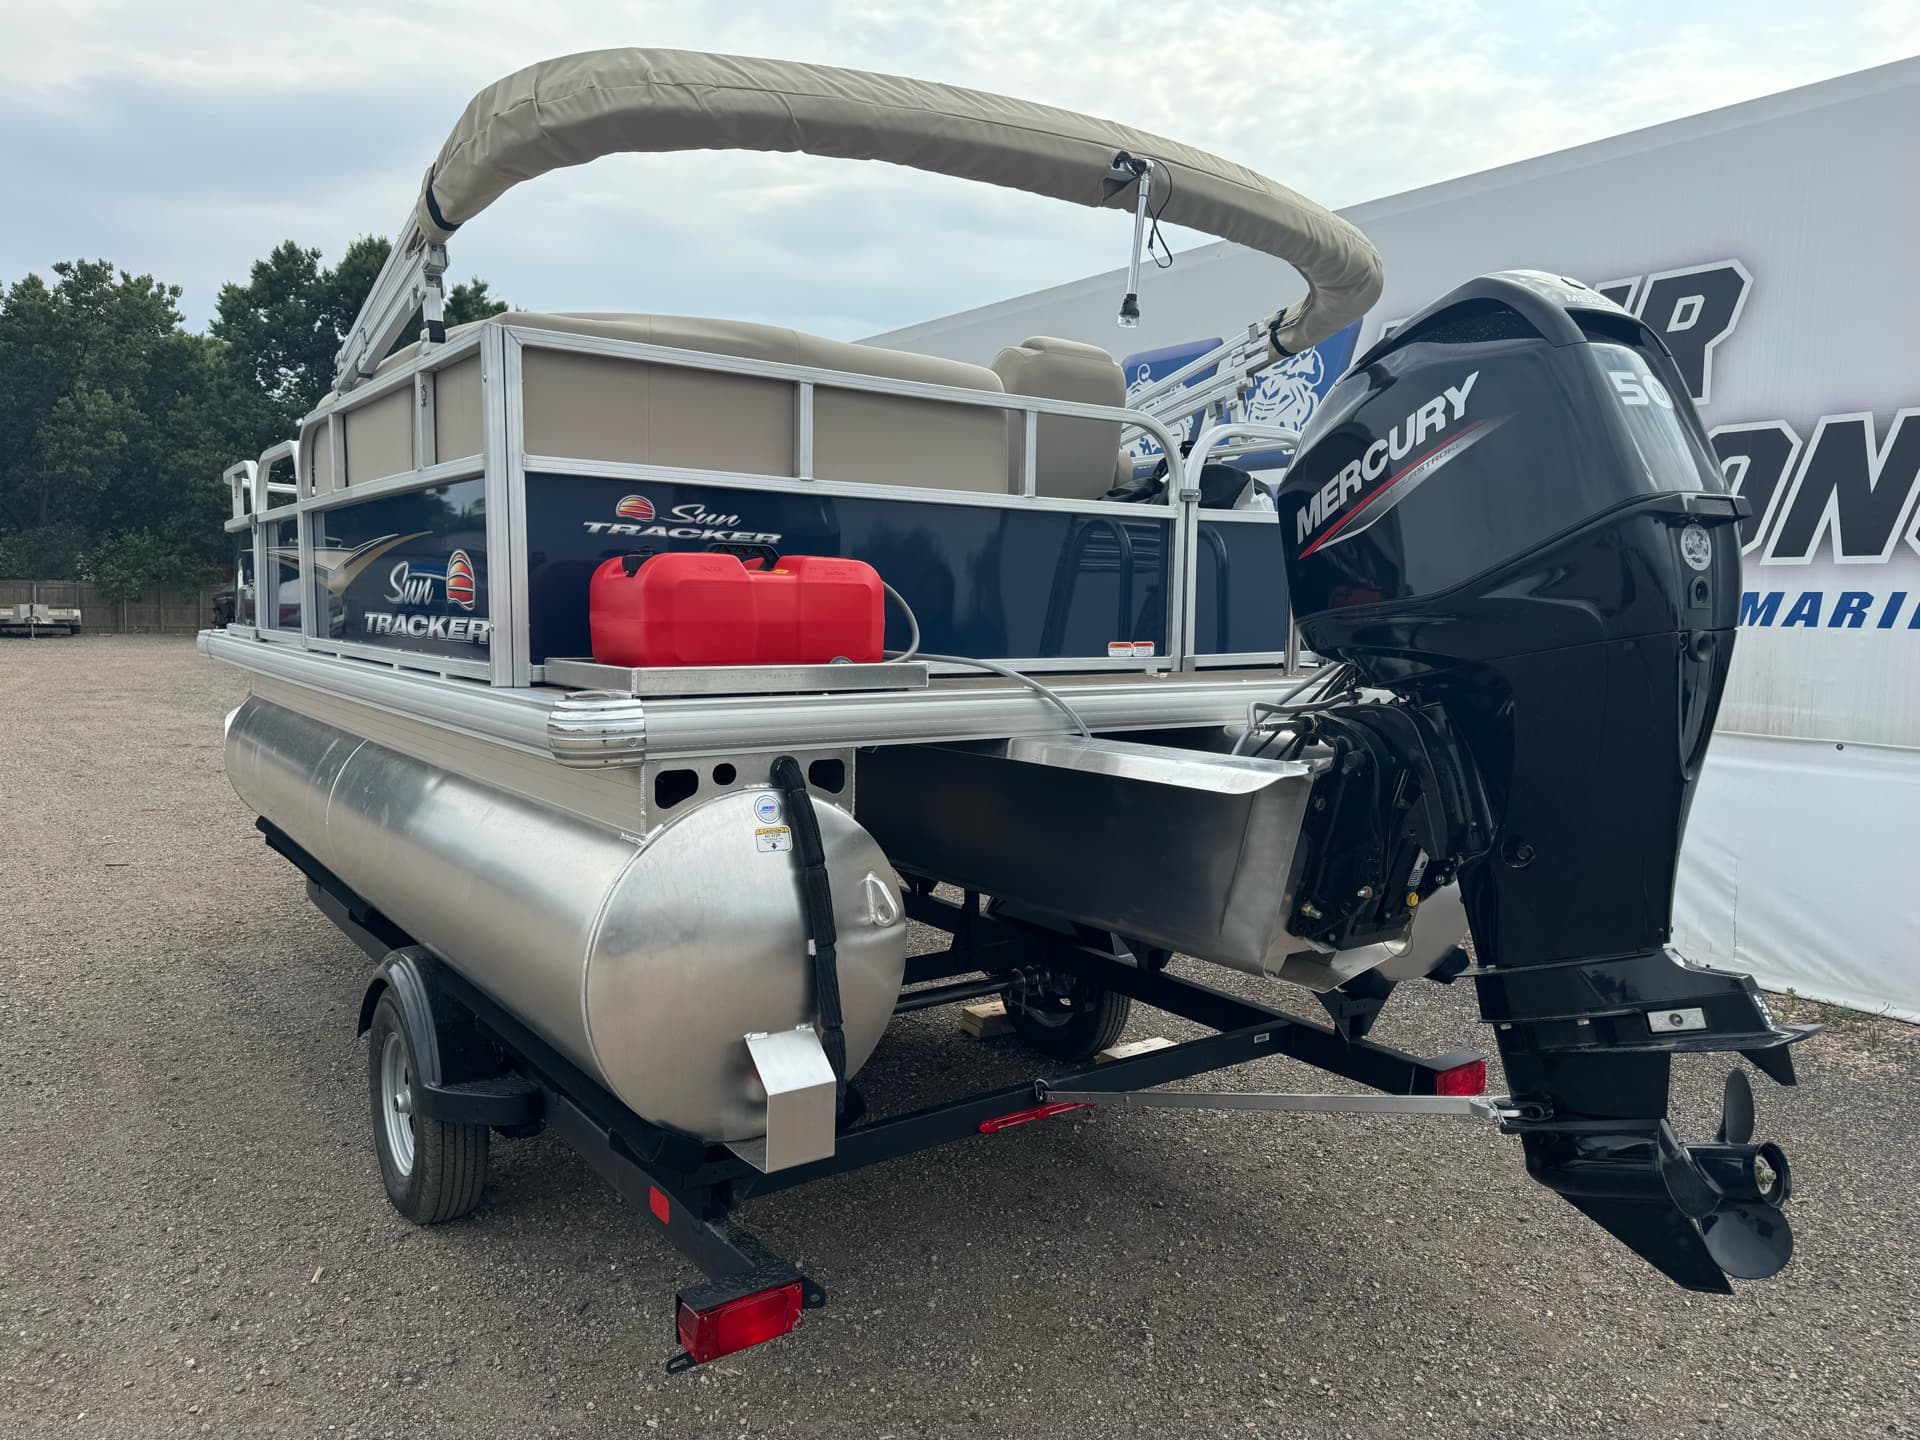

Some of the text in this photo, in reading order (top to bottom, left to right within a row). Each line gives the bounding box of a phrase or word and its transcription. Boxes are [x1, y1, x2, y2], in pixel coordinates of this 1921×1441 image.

[1297, 371, 1479, 544] MERCURY
[1707, 407, 1920, 566] ON
[584, 521, 782, 544] TRACKER
[659, 504, 741, 526] Sun
[384, 561, 434, 605] Sun
[364, 611, 491, 644] TRACKER
[1740, 591, 1920, 630] MARI
